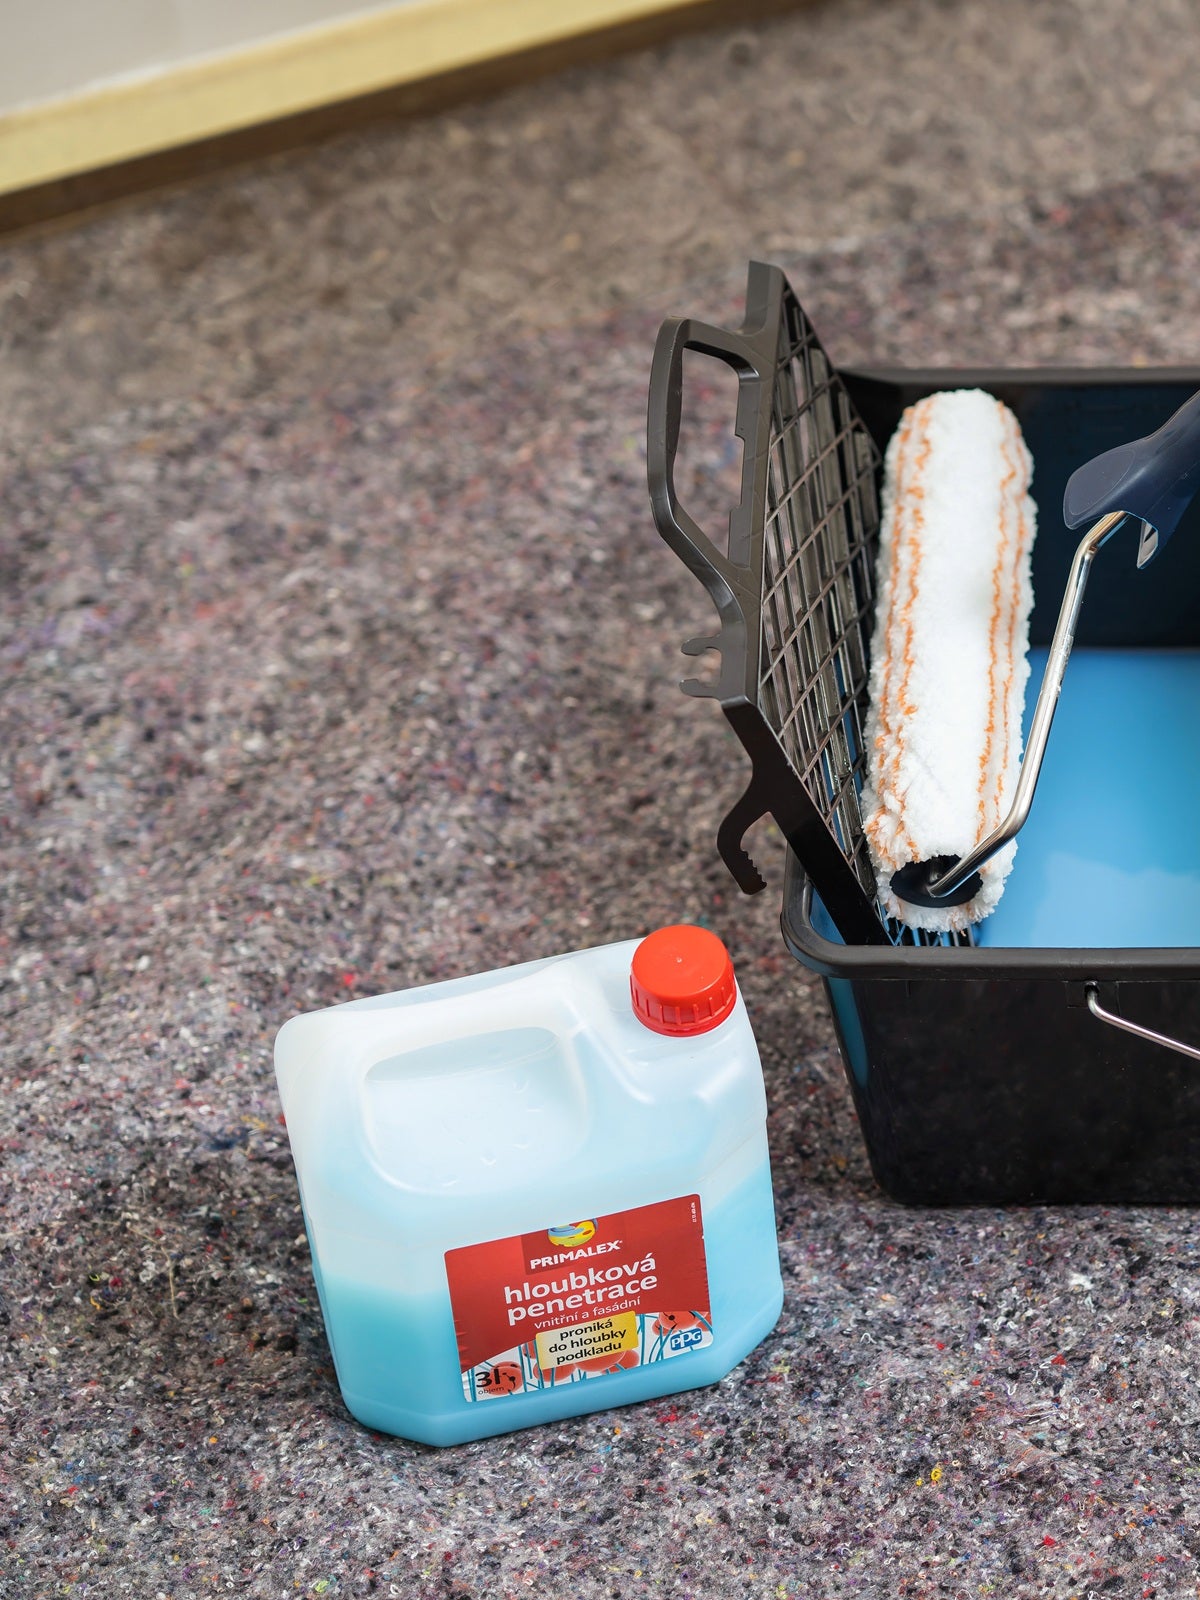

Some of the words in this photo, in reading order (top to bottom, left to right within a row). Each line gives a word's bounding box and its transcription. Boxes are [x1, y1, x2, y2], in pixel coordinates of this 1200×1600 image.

[530, 1240, 621, 1269] PRIMALEX
[504, 1252, 656, 1304] hloubková
[507, 1275, 658, 1326] penetrace
[534, 1311, 578, 1329] vnitřní
[581, 1311, 590, 1319] a
[593, 1296, 641, 1316] fasádní
[548, 1340, 567, 1353] do
[570, 1328, 627, 1350] hloubky
[560, 1318, 613, 1341] proniká
[671, 1330, 701, 1348] PPG
[556, 1341, 622, 1365] podkladu
[478, 1386, 505, 1395] objem
